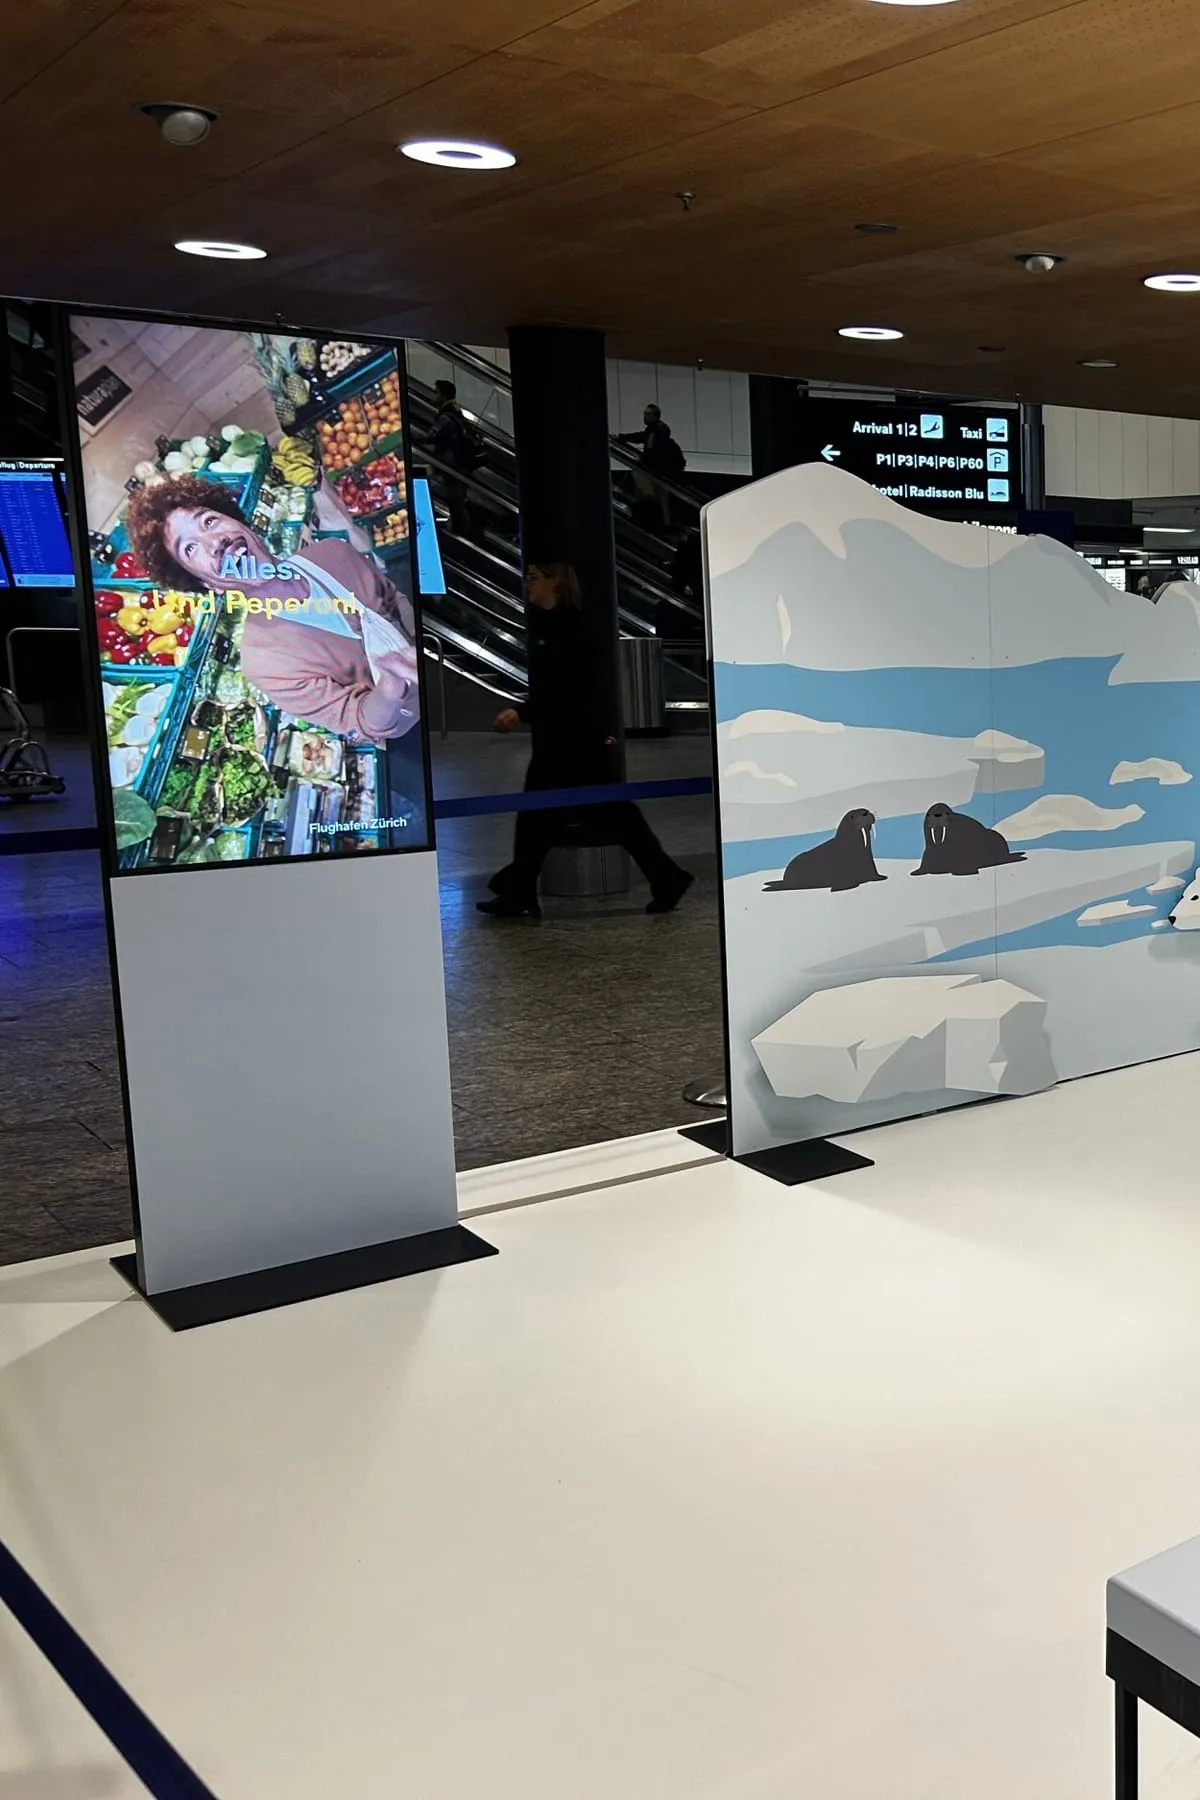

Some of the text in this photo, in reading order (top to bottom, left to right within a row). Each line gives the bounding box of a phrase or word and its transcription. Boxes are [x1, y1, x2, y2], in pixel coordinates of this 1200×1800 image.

[852, 421, 892, 434] Arrival
[960, 426, 982, 439] Taxi
[964, 488, 984, 499] Blu
[220, 556, 301, 580] Alles.
[152, 589, 365, 620] Und Peperoni.
[310, 816, 408, 834] Flughafen Zürich
